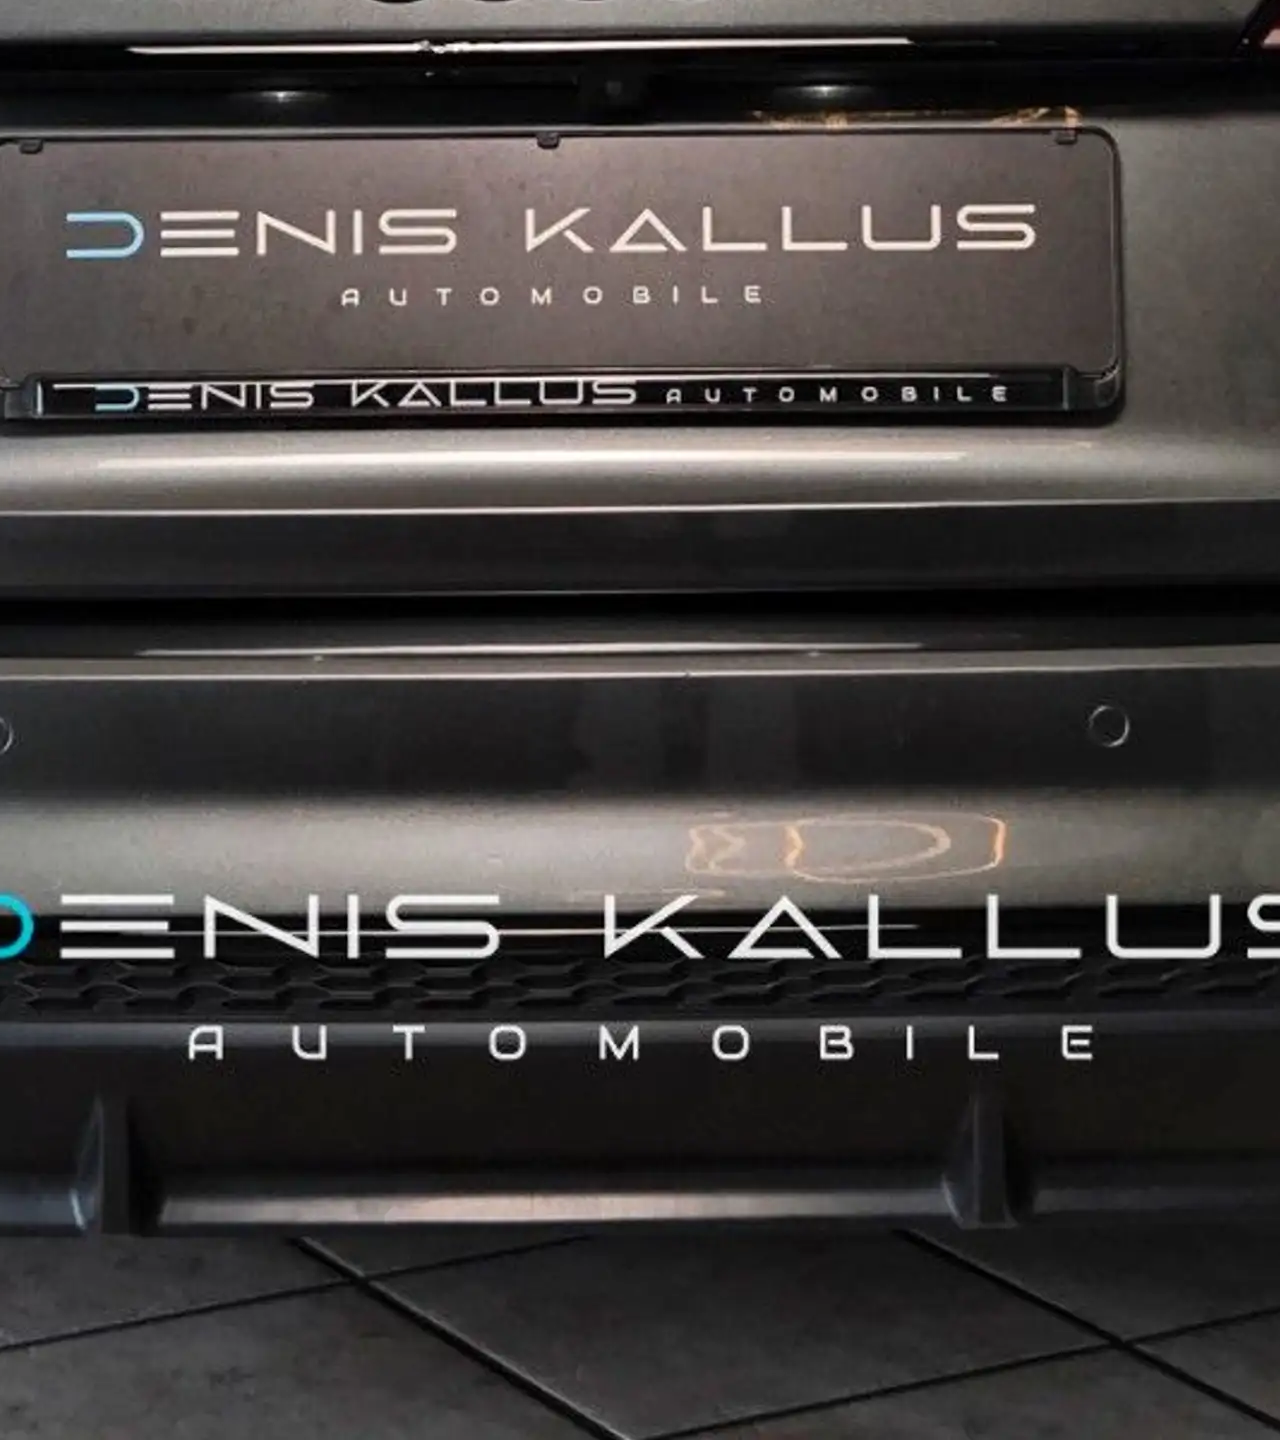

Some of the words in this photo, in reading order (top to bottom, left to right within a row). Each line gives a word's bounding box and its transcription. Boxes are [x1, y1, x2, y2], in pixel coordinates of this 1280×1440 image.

[65, 209, 458, 258] DENIS
[523, 203, 1037, 255] KALLUS
[340, 284, 766, 307] AUTOMOBILE
[94, 384, 316, 412] DENIS
[351, 380, 638, 408] KALLUS
[666, 386, 1009, 404] AUTOMOBILE
